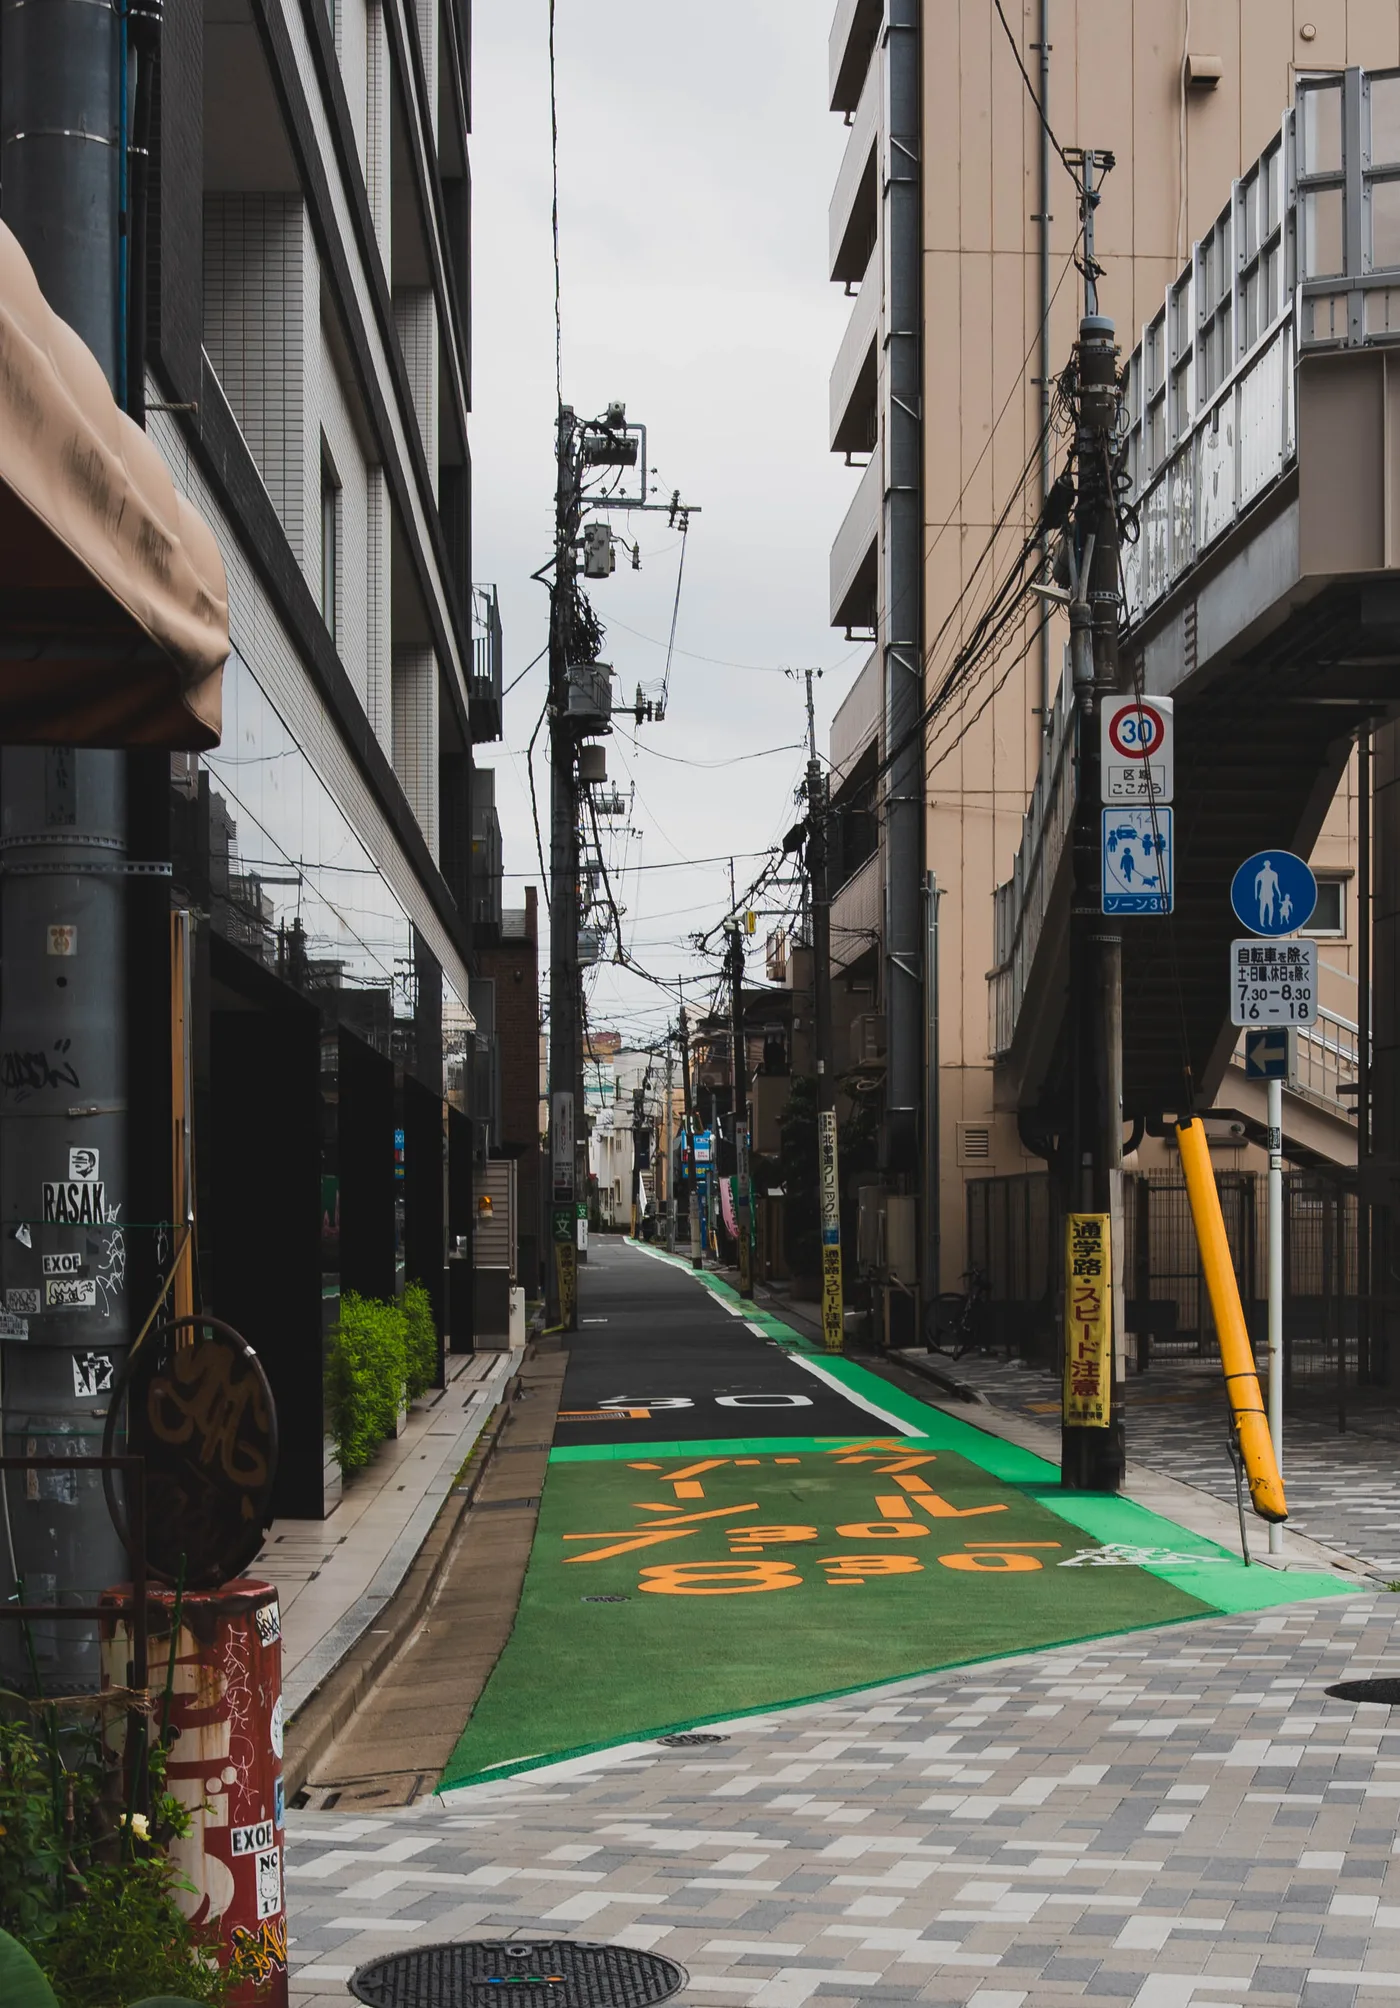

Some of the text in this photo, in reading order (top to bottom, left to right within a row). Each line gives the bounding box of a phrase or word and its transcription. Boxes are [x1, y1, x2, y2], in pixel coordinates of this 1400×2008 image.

[1121, 719, 1153, 744] 30
[1112, 783, 1163, 795] ここから
[1107, 898, 1168, 911] ゾーン30
[1237, 947, 1309, 963] 自転車を除く
[43, 1183, 105, 1224] RASAK
[1071, 1221, 1102, 1397] 通学路・スピード注意
[597, 1394, 814, 1410] 30
